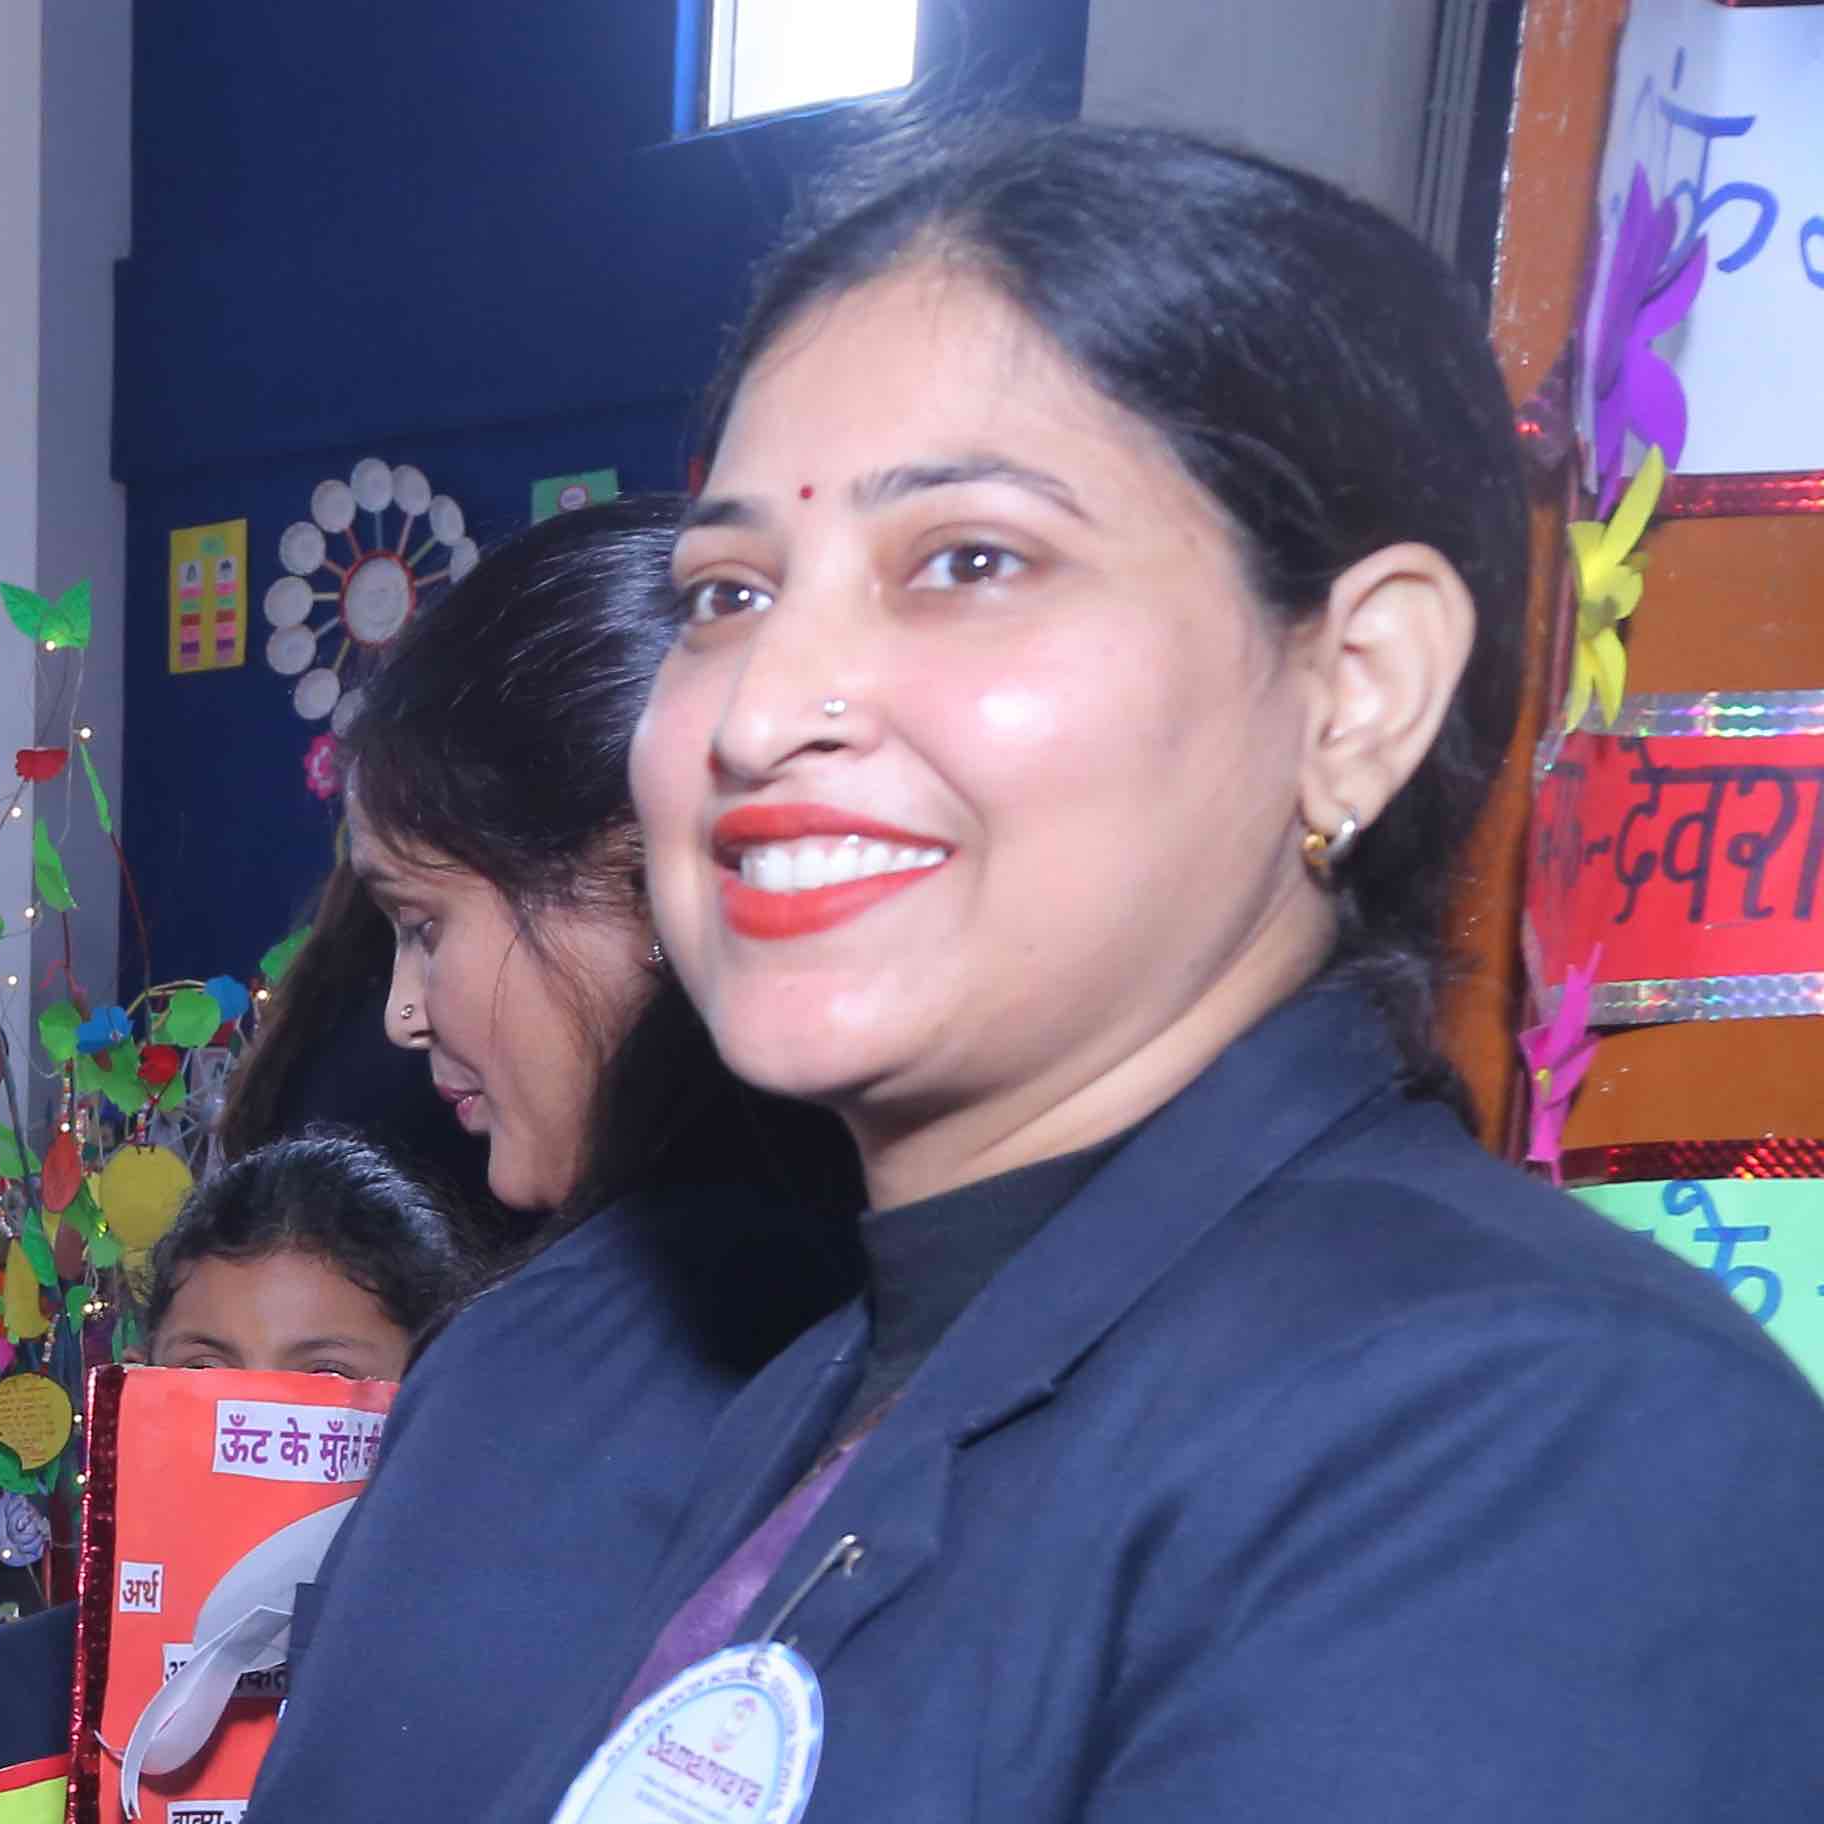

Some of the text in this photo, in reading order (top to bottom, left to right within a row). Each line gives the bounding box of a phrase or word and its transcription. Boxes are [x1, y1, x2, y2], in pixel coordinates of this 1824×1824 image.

[221, 1414, 272, 1463] ऊँट
[280, 1418, 310, 1465] के
[319, 1420, 350, 1481] मुँह
[122, 1575, 159, 1611] अर्थ
